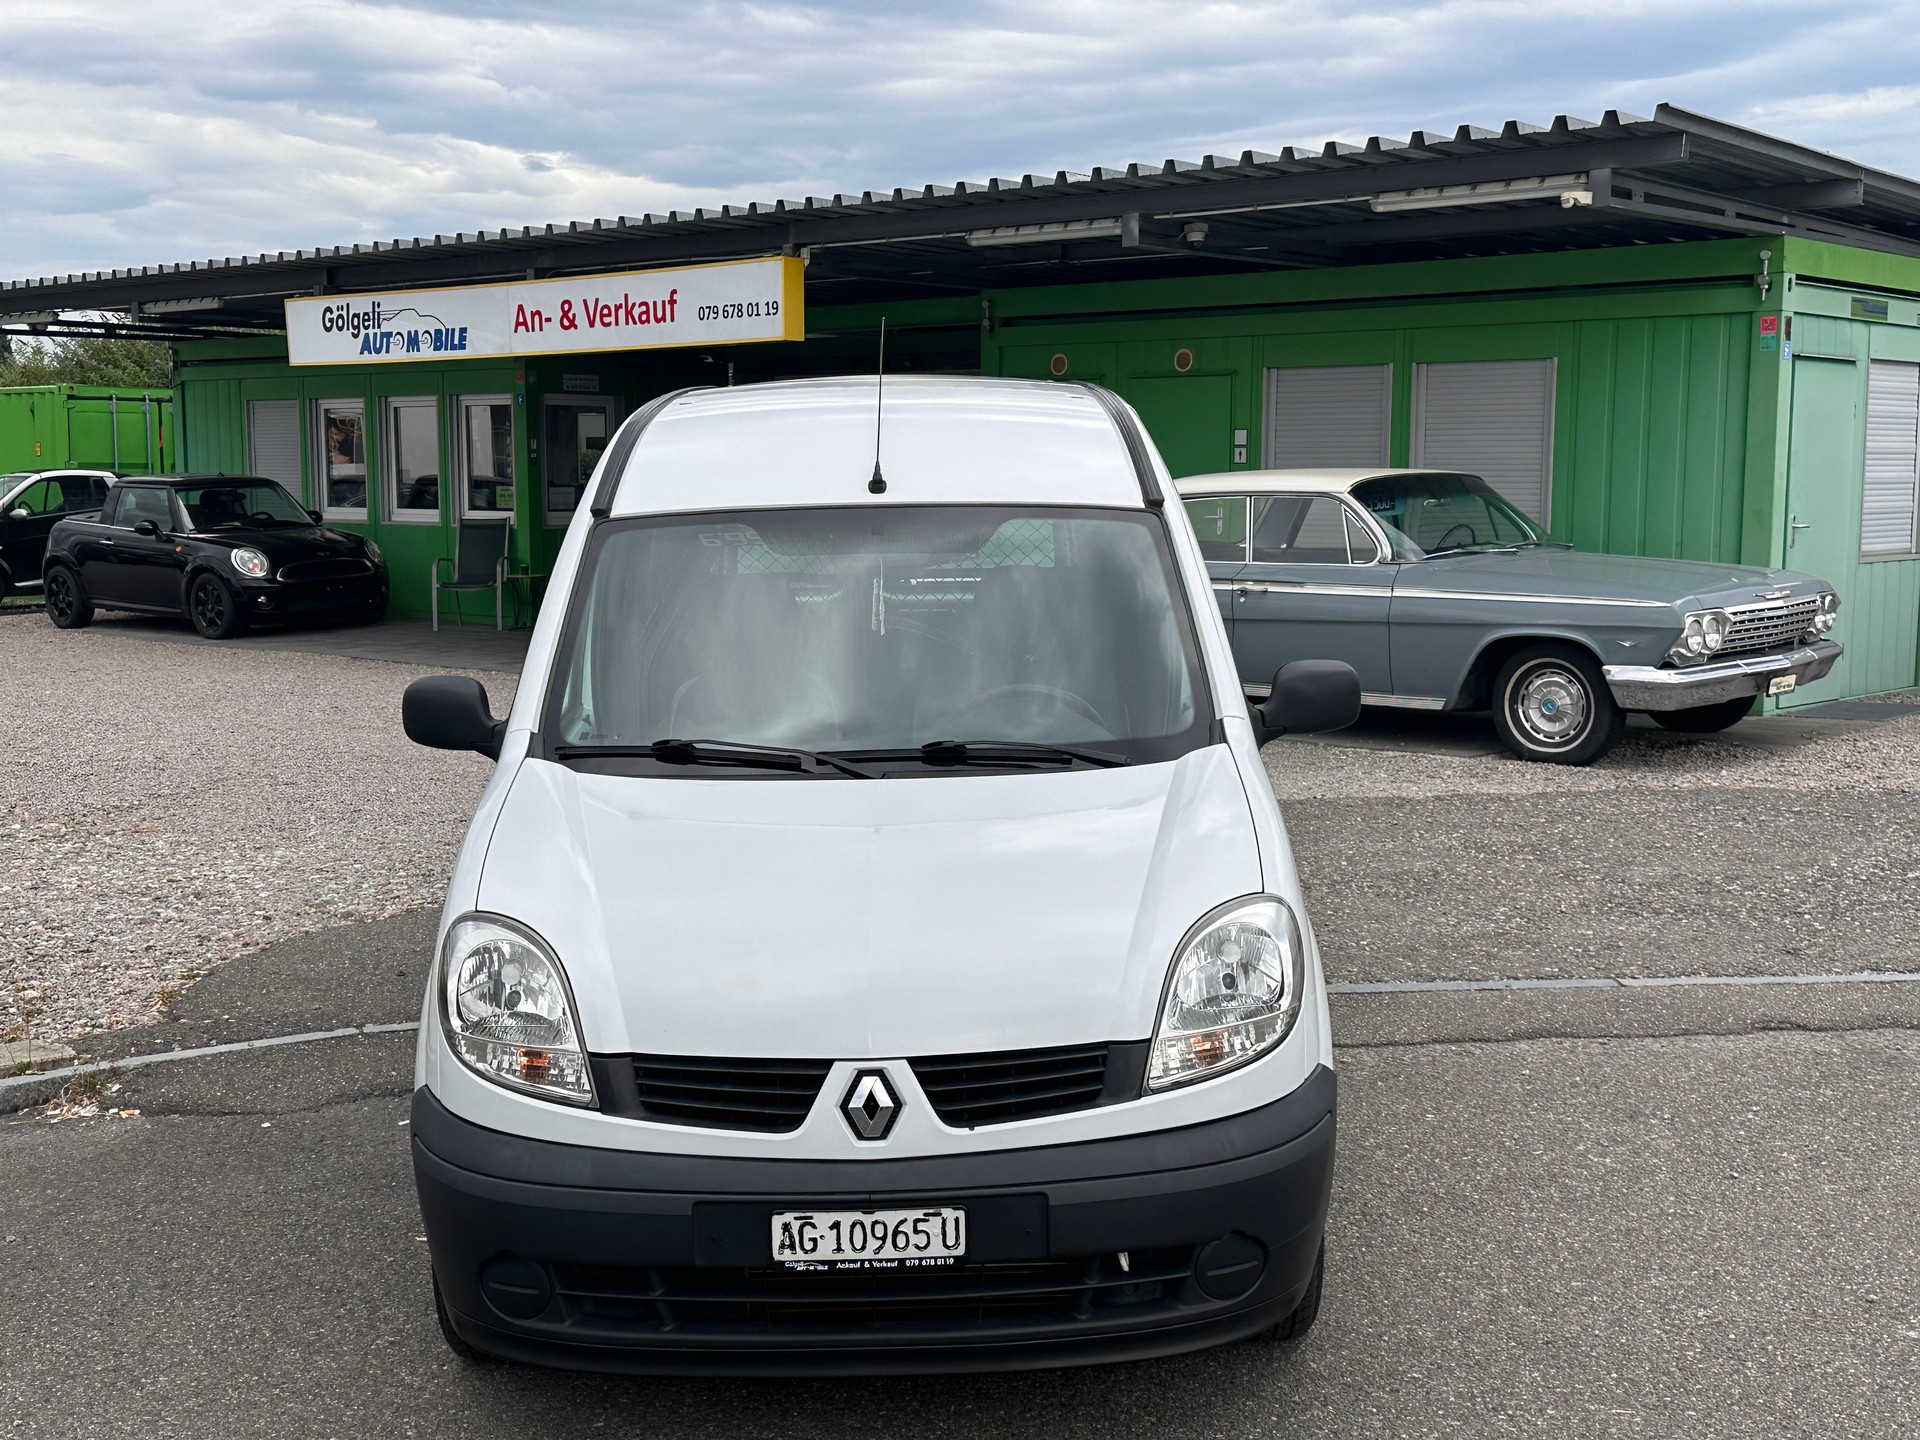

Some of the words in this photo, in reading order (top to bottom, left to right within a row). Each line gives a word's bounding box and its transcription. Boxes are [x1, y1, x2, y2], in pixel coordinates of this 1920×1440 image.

[321, 300, 381, 339] Gölgeli
[513, 303, 552, 333] An-
[559, 298, 578, 331] &
[582, 288, 678, 328] Verkauf
[698, 305, 719, 321] 079
[722, 303, 744, 320] 678
[746, 302, 761, 318] 01
[764, 300, 779, 317] 19
[359, 326, 468, 355] AUTOMOBILE
[905, 1259, 919, 1267] 079
